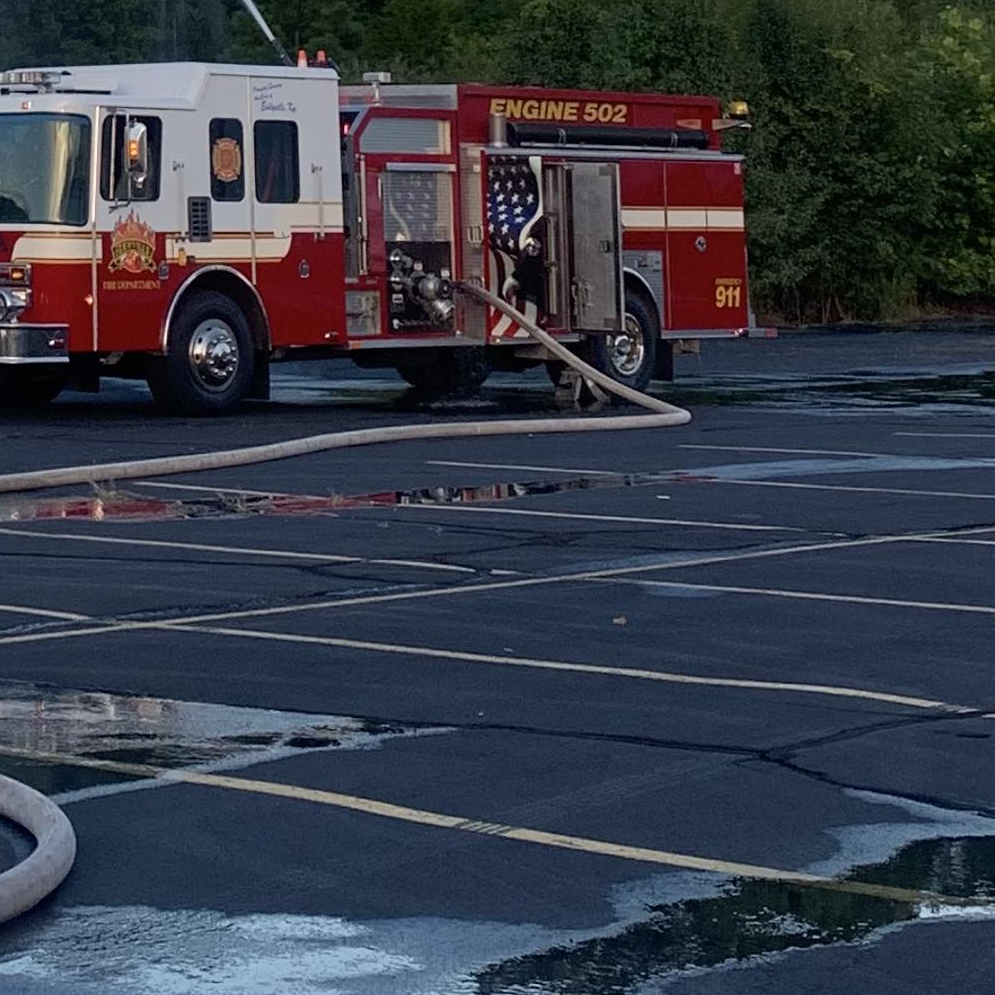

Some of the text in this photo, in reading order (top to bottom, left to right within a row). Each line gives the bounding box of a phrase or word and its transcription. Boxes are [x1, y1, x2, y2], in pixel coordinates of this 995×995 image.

[490, 98, 627, 122] ENGINE 502
[715, 285, 740, 308] 911
